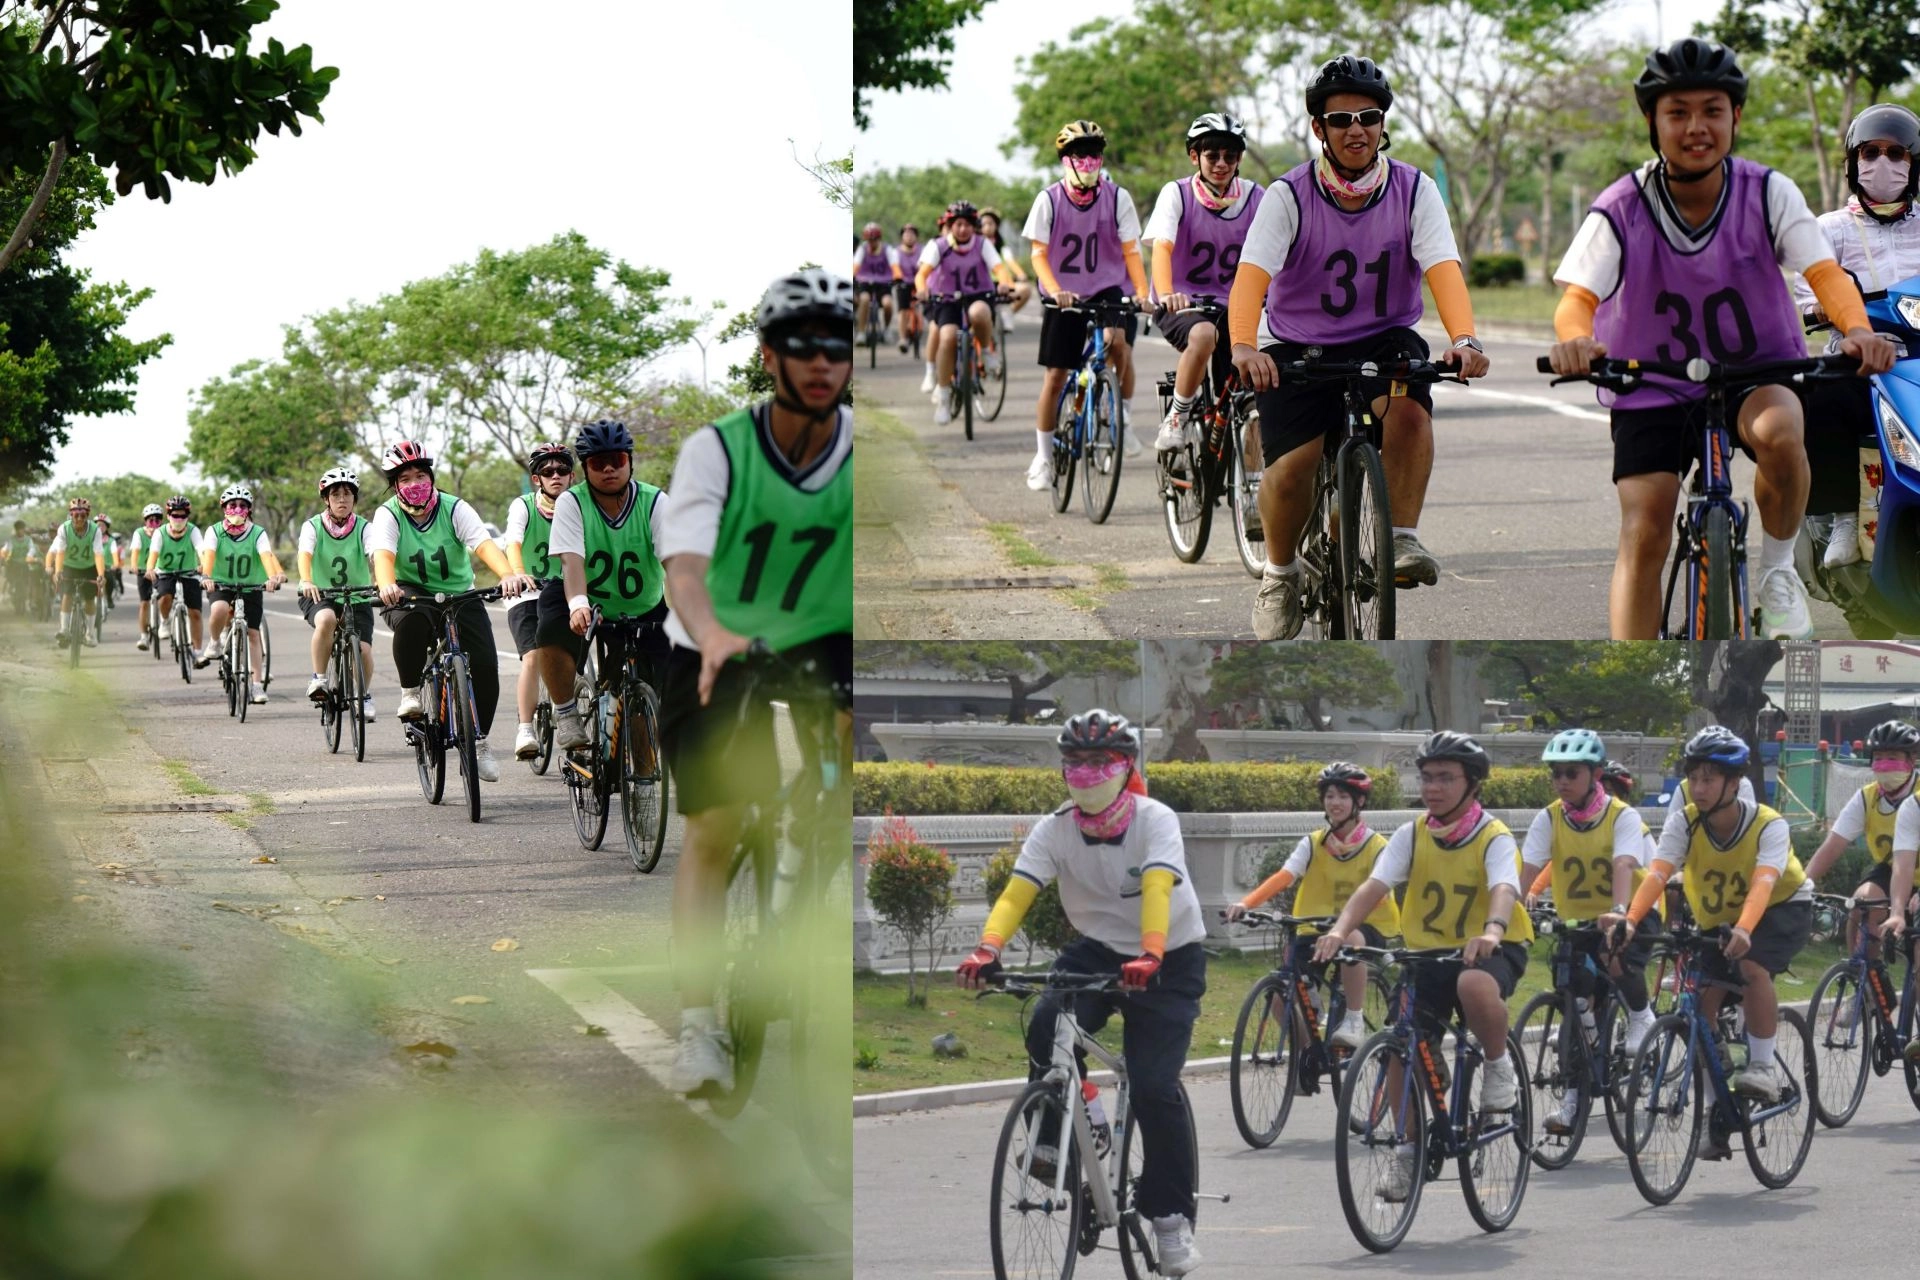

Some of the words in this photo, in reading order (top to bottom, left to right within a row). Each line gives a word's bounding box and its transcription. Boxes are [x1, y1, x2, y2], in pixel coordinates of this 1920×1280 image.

[1059, 231, 1098, 274] 20
[1185, 241, 1242, 285] 29
[950, 266, 979, 290] 14
[1320, 249, 1391, 318] 31
[1655, 286, 1757, 364] 30
[69, 544, 90, 561] 24
[163, 551, 186, 571] 27
[225, 553, 250, 579] 10
[330, 556, 348, 587] 3
[409, 546, 450, 584] 11
[738, 520, 837, 613] 17
[587, 550, 644, 600] 26
[1563, 856, 1613, 899] 23
[1421, 880, 1478, 938] 27
